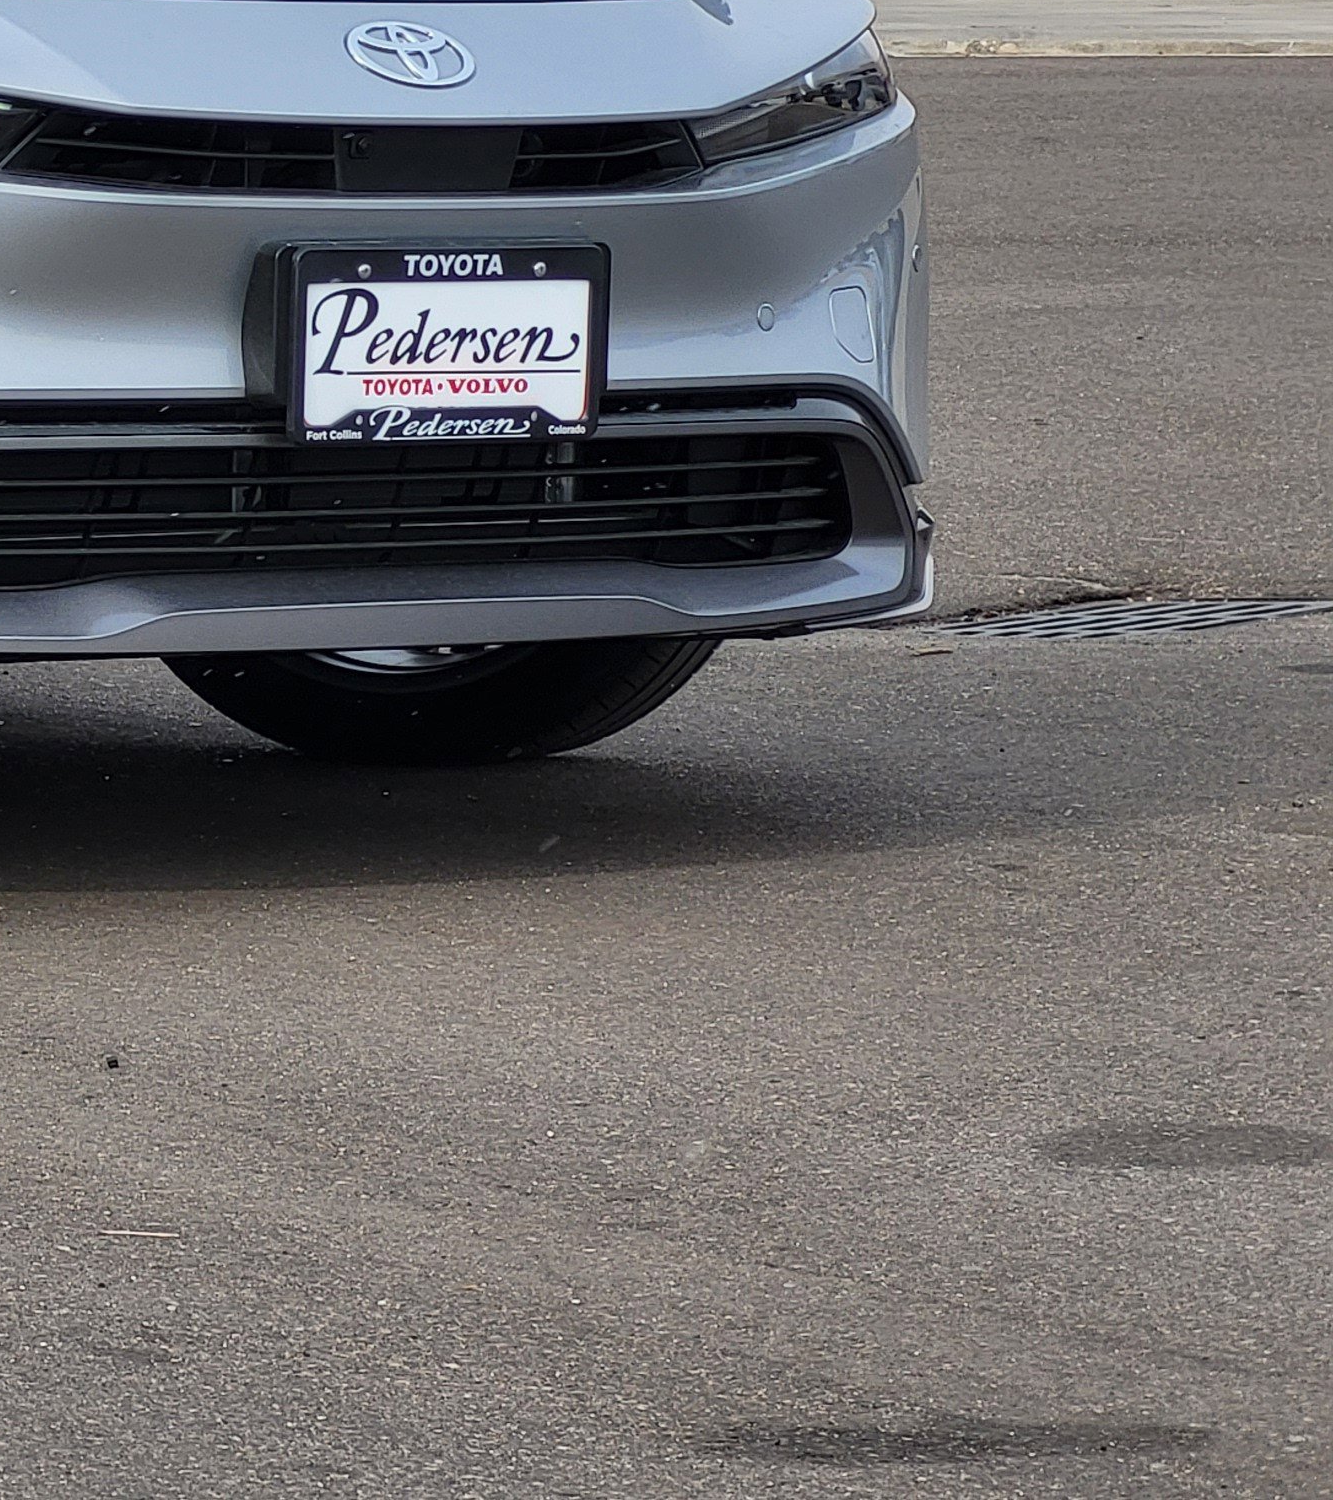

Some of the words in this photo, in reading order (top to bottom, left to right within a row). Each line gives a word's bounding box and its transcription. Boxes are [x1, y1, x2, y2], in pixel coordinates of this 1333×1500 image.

[403, 254, 504, 277] TOYOTA
[311, 288, 581, 376] Pedersen
[362, 378, 434, 397] TOYOTA
[446, 377, 529, 395] VOLVO
[305, 430, 328, 441] Fort
[329, 429, 364, 441] Collins
[547, 424, 588, 436] Colorado
[368, 405, 532, 441] Pedersen
